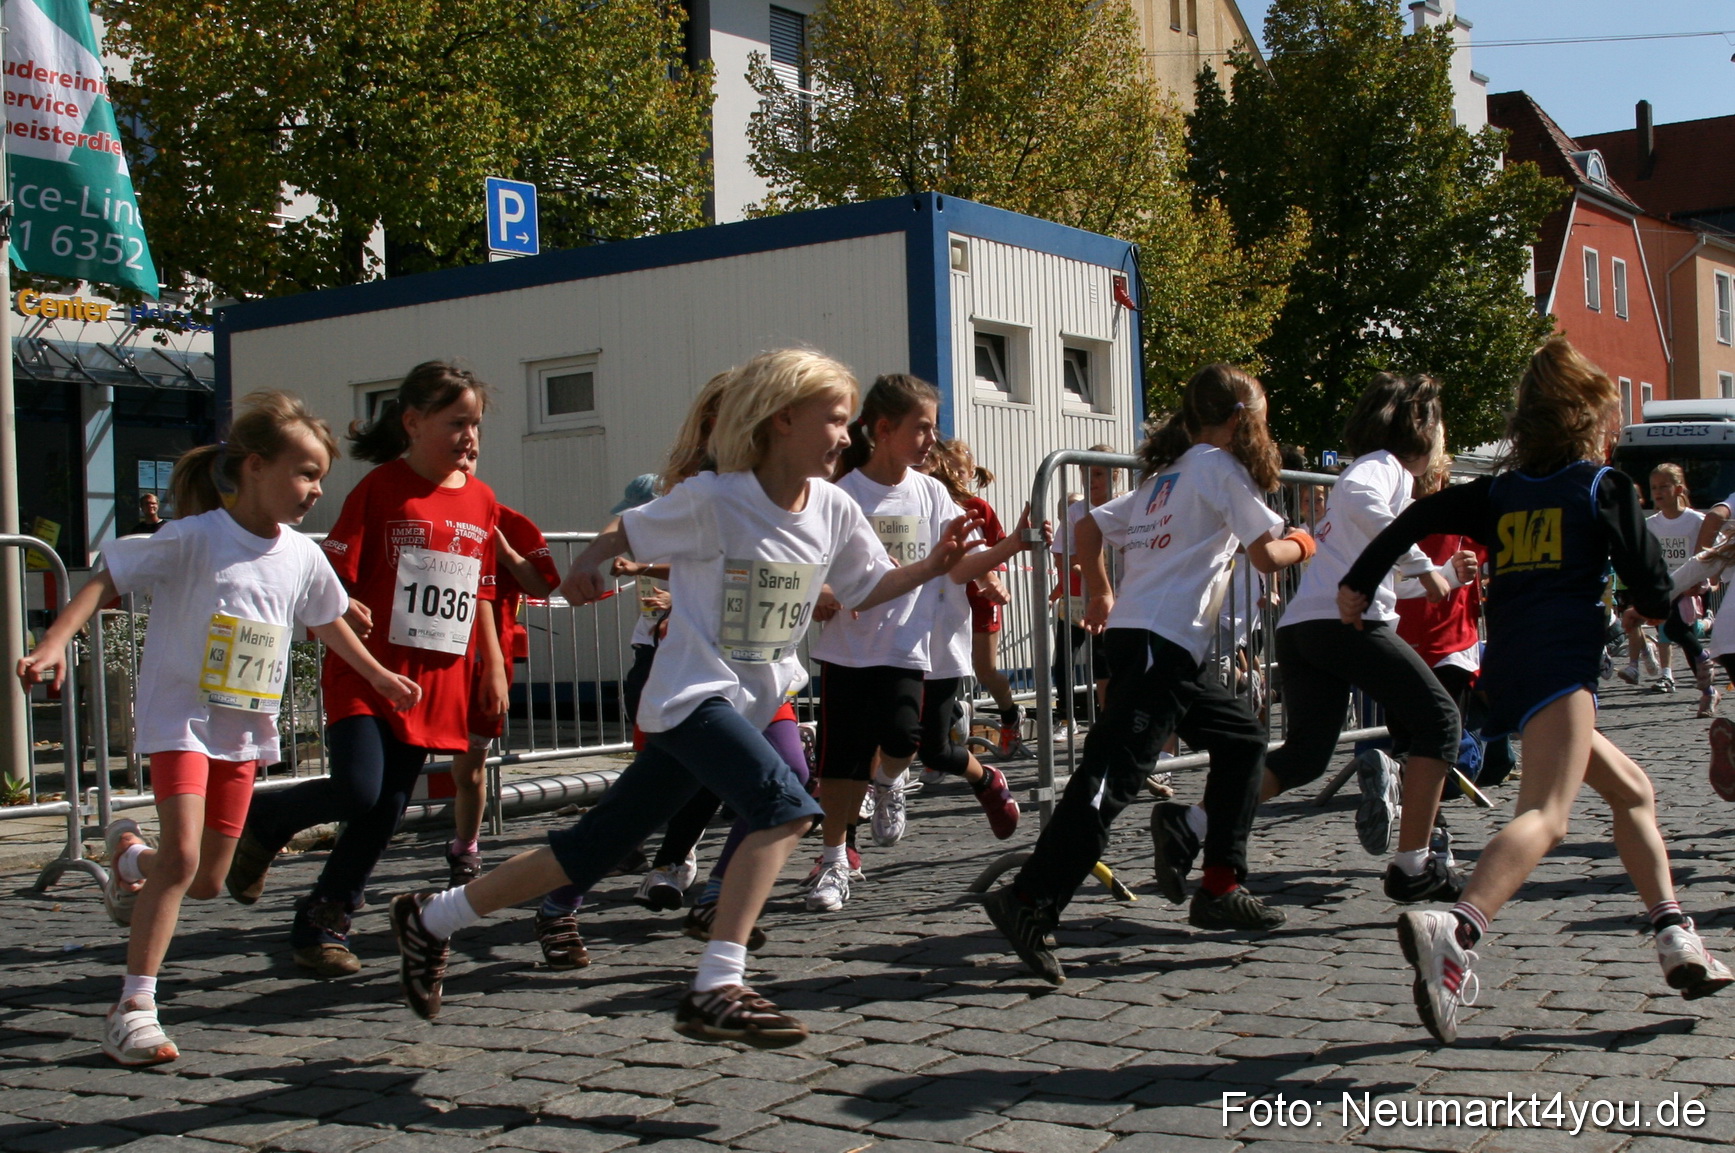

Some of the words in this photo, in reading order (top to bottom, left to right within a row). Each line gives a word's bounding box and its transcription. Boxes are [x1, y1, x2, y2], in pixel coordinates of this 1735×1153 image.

[4, 90, 79, 117] ervice
[498, 188, 525, 241] P
[51, 225, 143, 270] 6352
[17, 288, 111, 322] Center
[1647, 425, 1710, 437] BOCK
[392, 528, 425, 536] IMMER
[879, 520, 909, 534] Celina
[1496, 508, 1563, 568] SVA
[391, 537, 425, 545] WIEDER
[416, 556, 472, 579] SANDRA
[758, 568, 800, 590] Sarah
[727, 597, 743, 612] K3
[759, 601, 811, 629] 7190
[240, 626, 275, 648] Marie
[210, 647, 225, 661] K3
[237, 654, 283, 683] 7115
